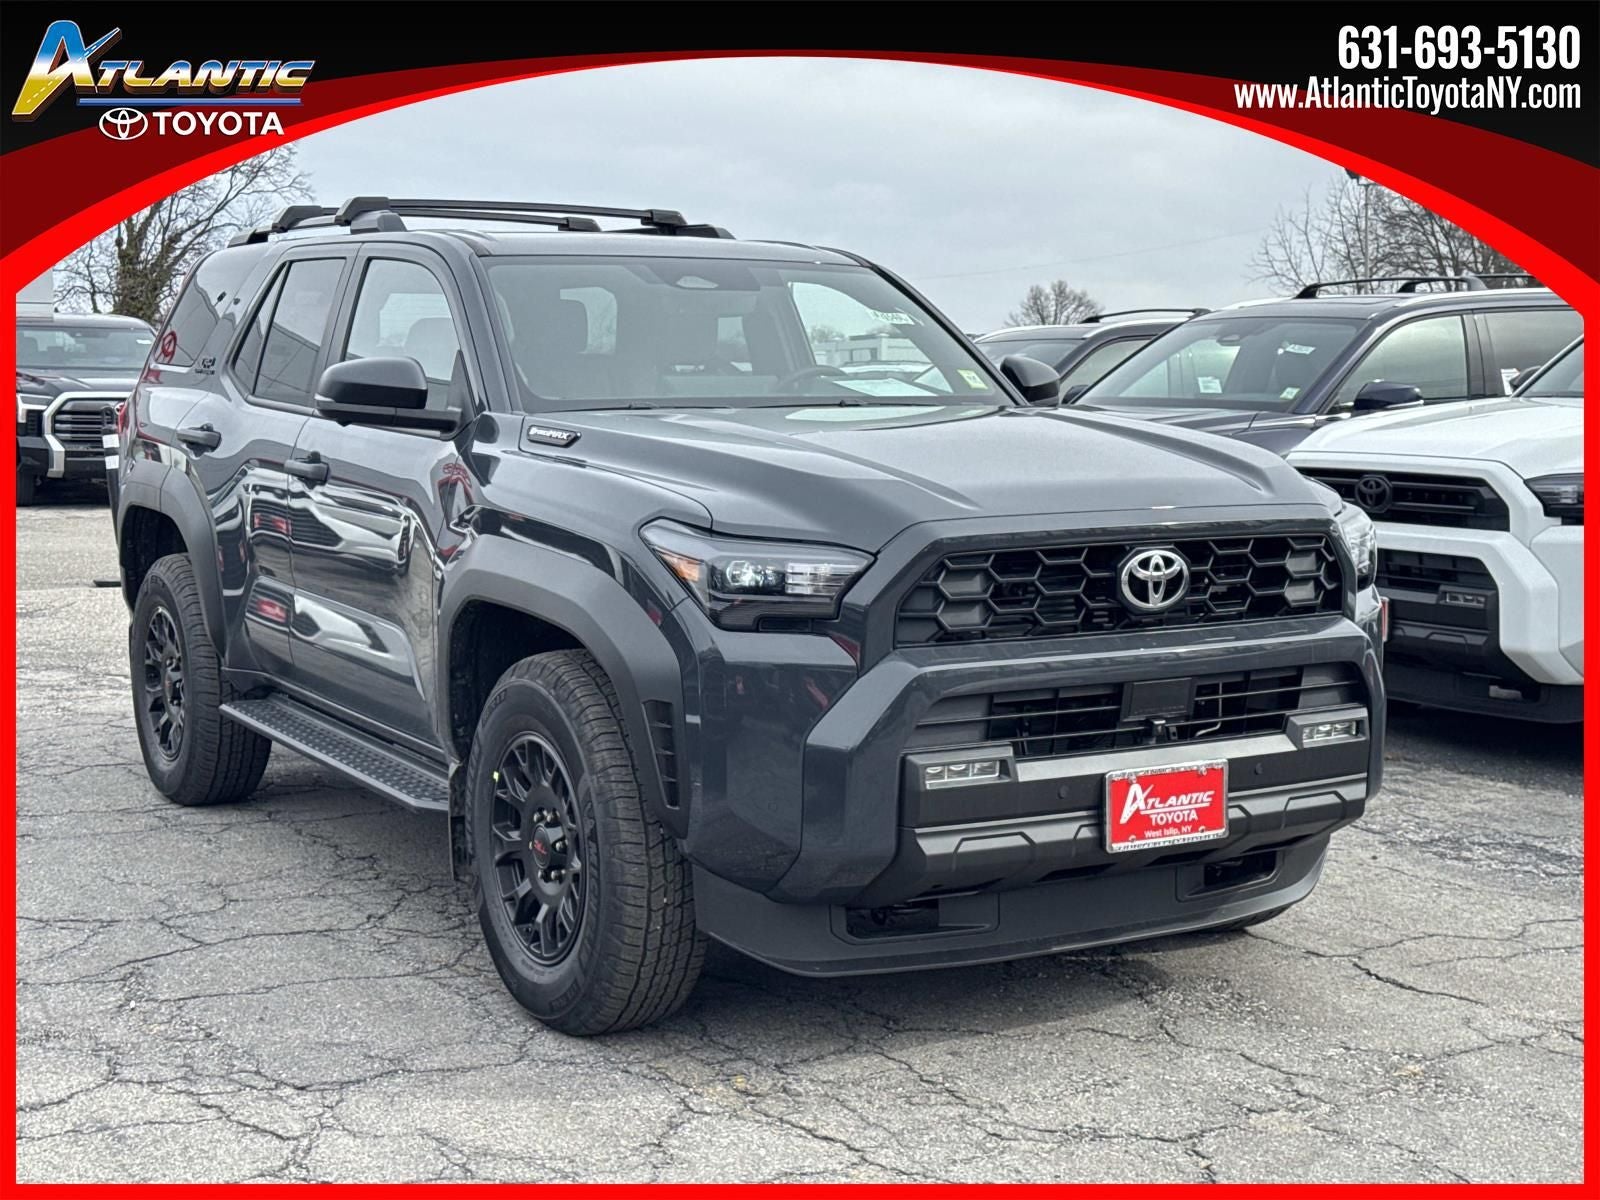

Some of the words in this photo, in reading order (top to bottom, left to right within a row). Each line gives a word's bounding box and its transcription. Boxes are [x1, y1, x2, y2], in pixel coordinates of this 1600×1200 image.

[1119, 783, 1216, 824] ATLANTIC
[1149, 809, 1199, 826] TOYOTA
[1144, 828, 1163, 838] West
[1163, 826, 1181, 836] Islip,
[1181, 825, 1193, 833] NY
